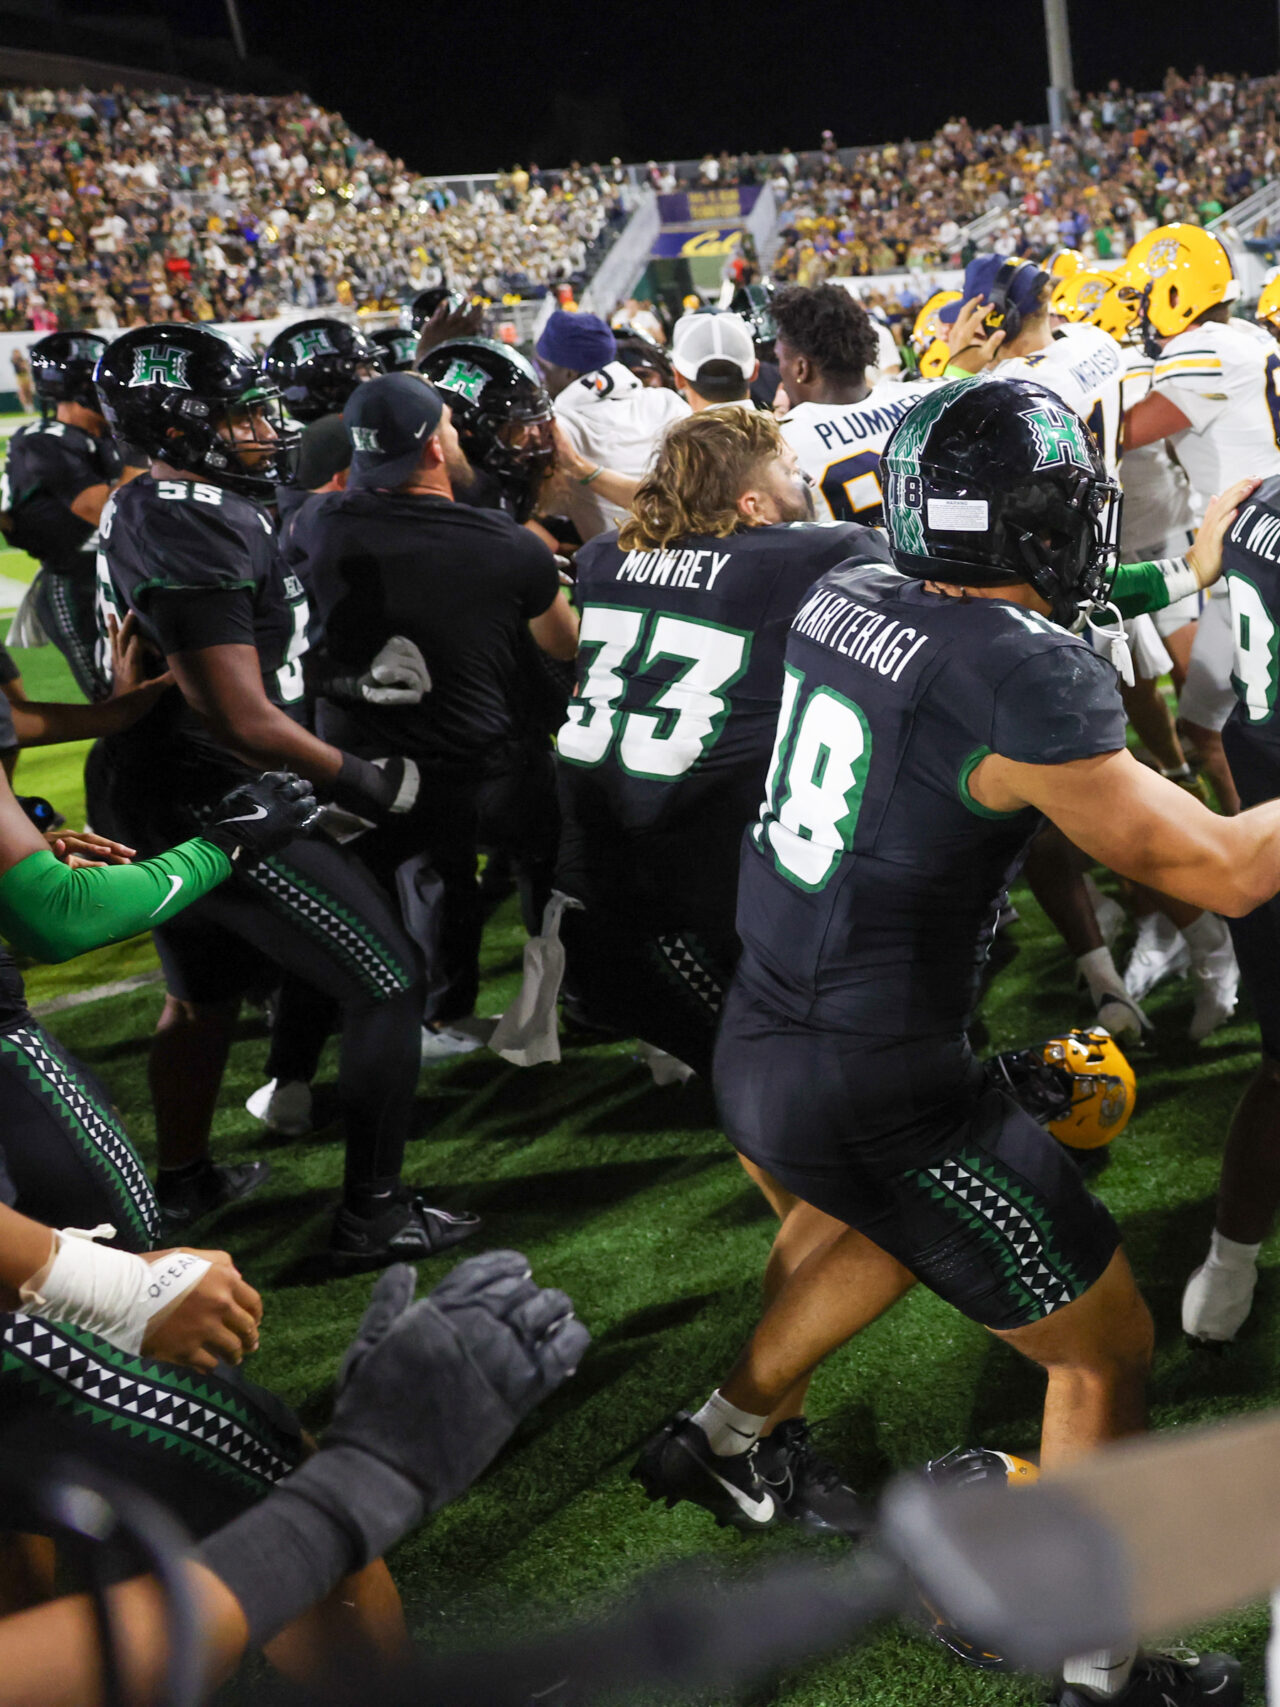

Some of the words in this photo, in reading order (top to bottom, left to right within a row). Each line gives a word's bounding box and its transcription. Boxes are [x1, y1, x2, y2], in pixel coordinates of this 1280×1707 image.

[681, 230, 742, 257] Cal
[128, 345, 193, 391] H
[434, 357, 494, 408] H
[1016, 405, 1096, 476] H
[157, 480, 223, 505] 55
[889, 473, 923, 510] 18
[616, 548, 732, 591] MOWREY
[791, 588, 929, 683] MARITERAGI
[556, 601, 755, 784] 33
[750, 661, 873, 894] 18
